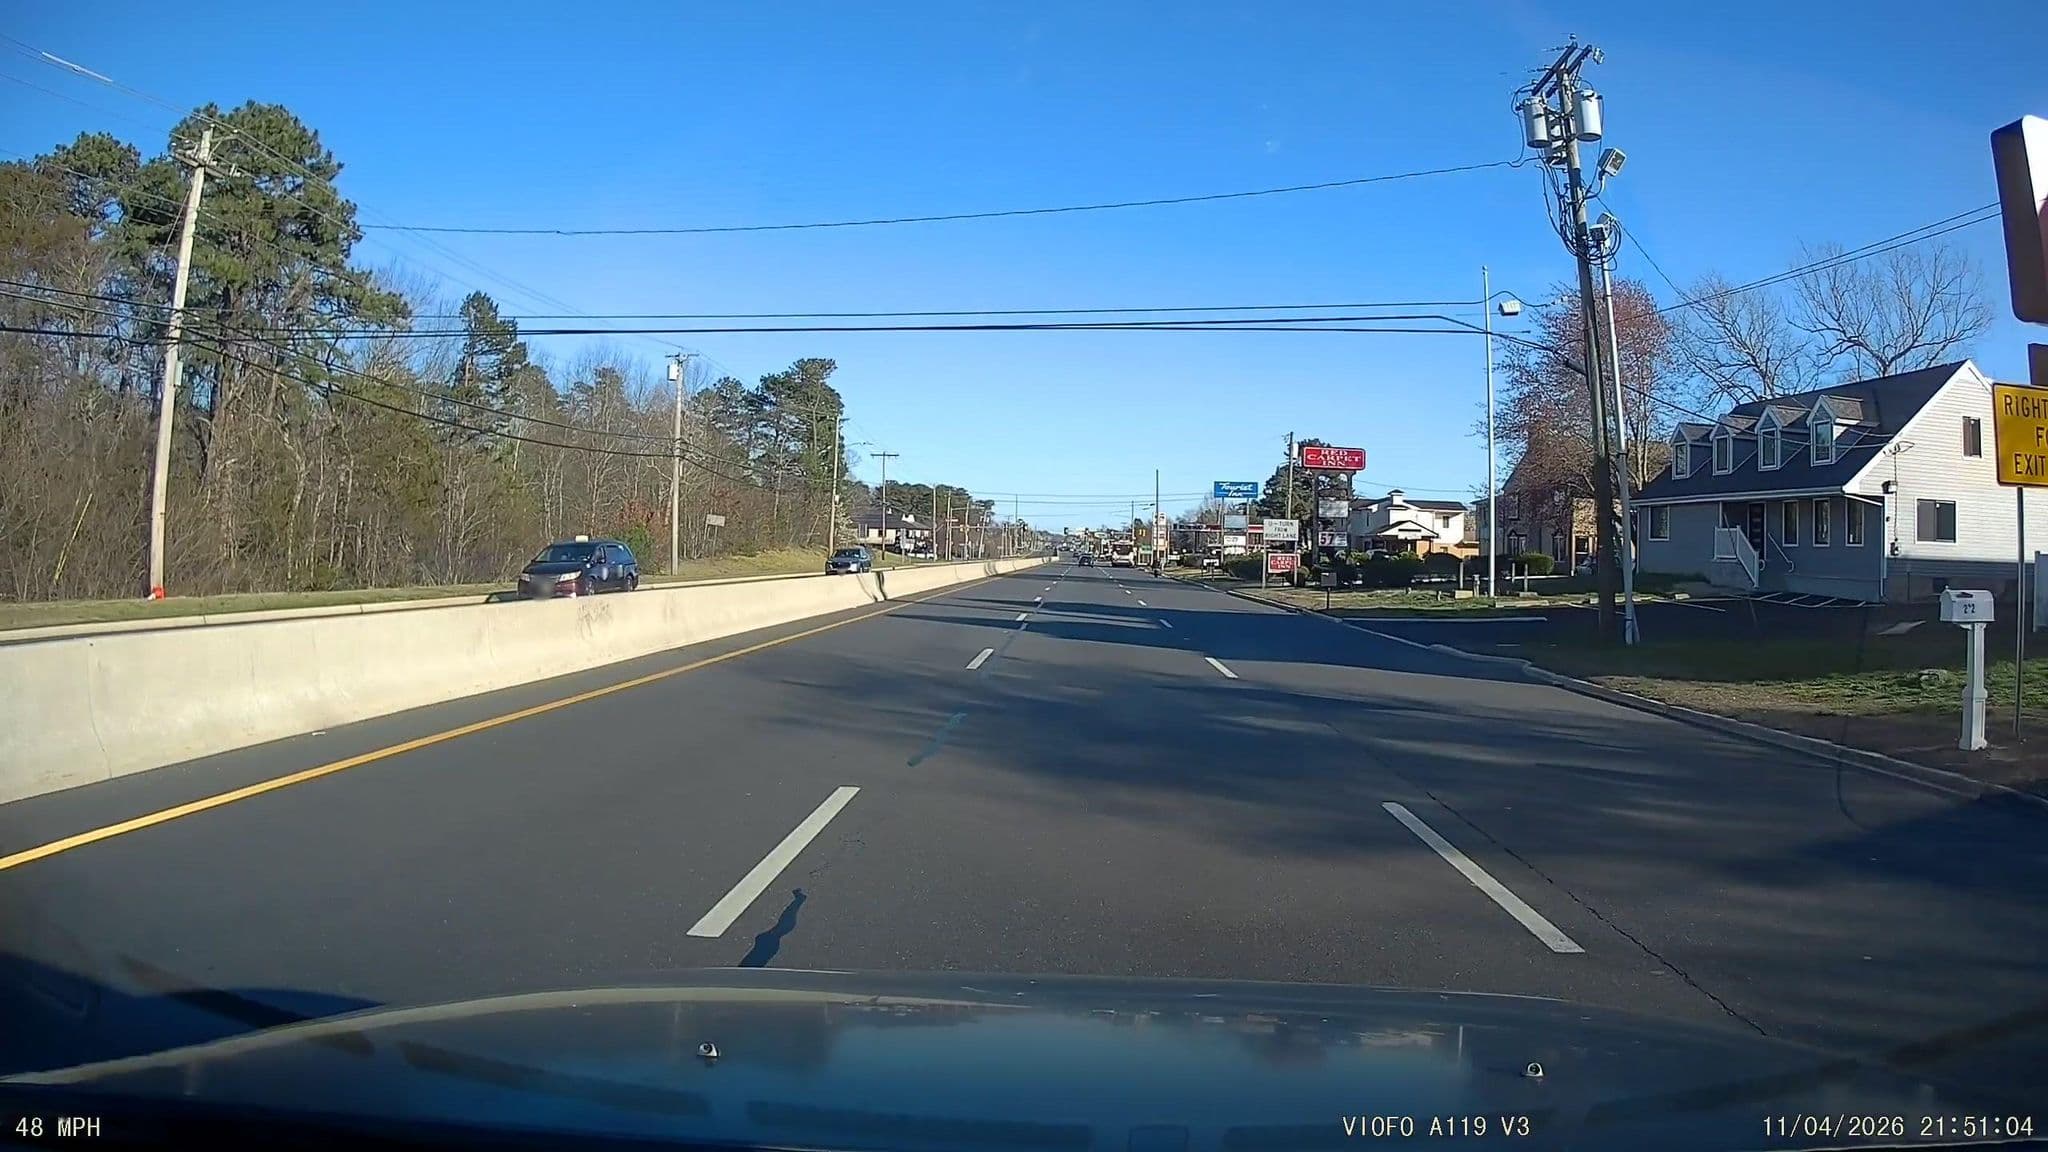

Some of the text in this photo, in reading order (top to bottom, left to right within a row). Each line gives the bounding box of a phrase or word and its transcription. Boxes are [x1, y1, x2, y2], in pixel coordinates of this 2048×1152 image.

[2003, 394, 2048, 420] RIGHT
[2036, 426, 2048, 448] F
[1307, 454, 1361, 462] CARPET
[2014, 453, 2046, 477] EXIT
[1219, 482, 1254, 491] Tourist
[1320, 533, 1335, 545] 57
